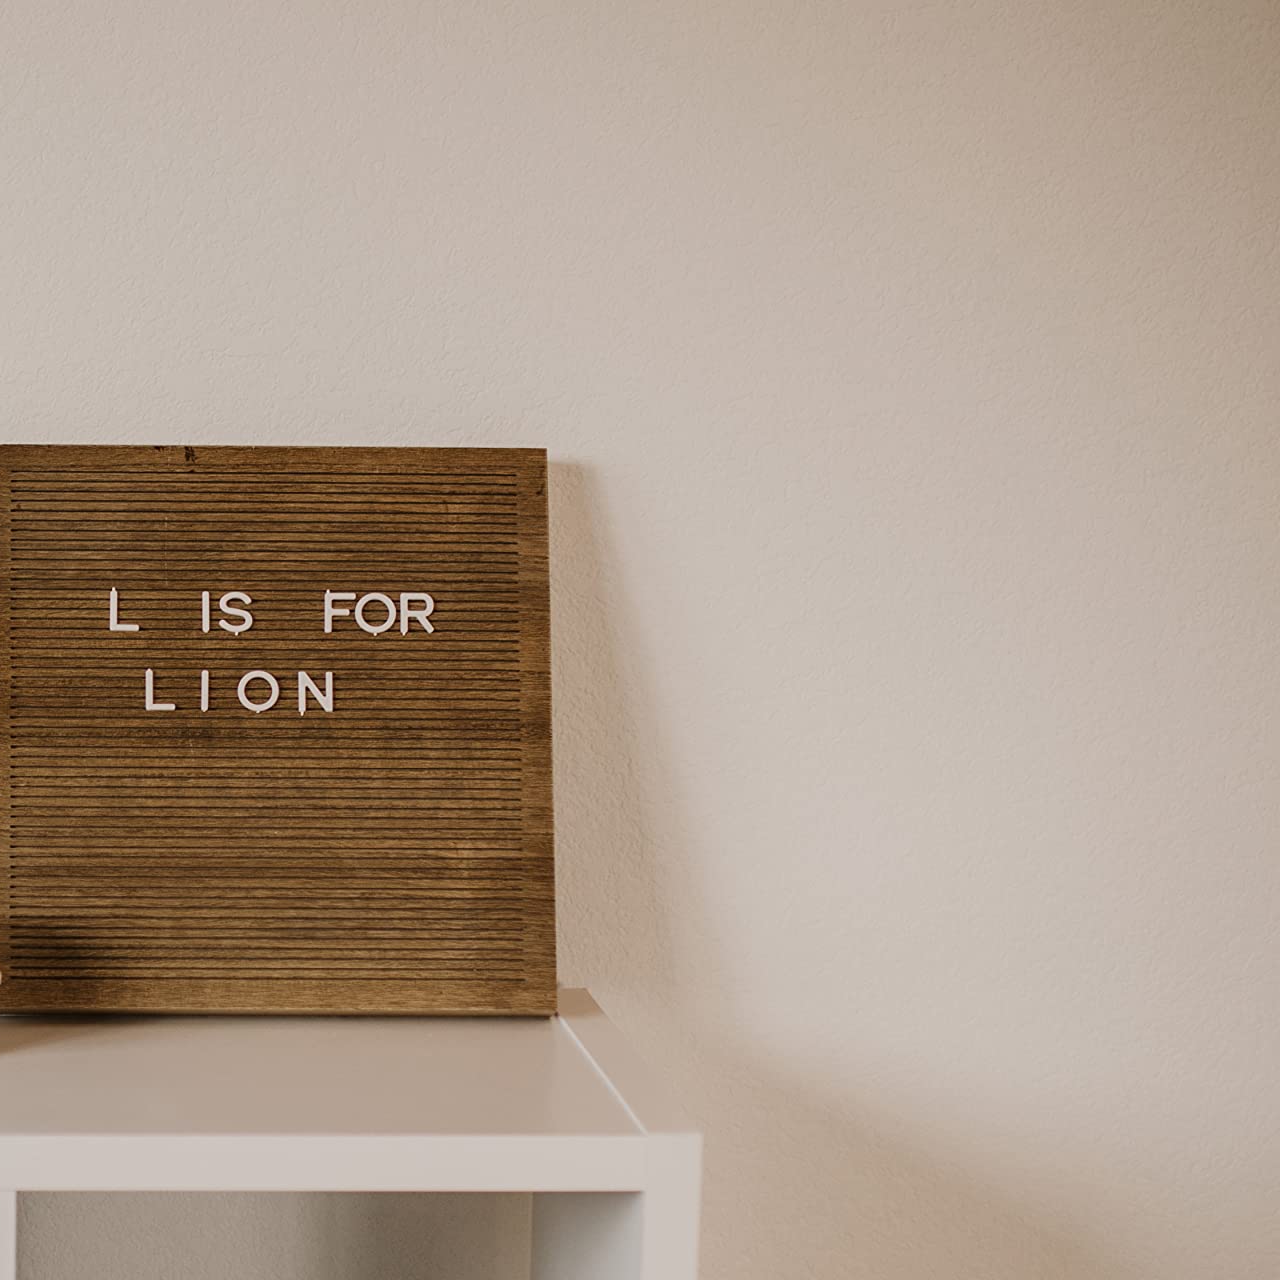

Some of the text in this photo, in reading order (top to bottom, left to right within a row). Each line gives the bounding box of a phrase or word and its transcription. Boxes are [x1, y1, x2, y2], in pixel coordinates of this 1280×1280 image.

[109, 587, 434, 636] L IS FOR
[145, 668, 333, 716] LION
